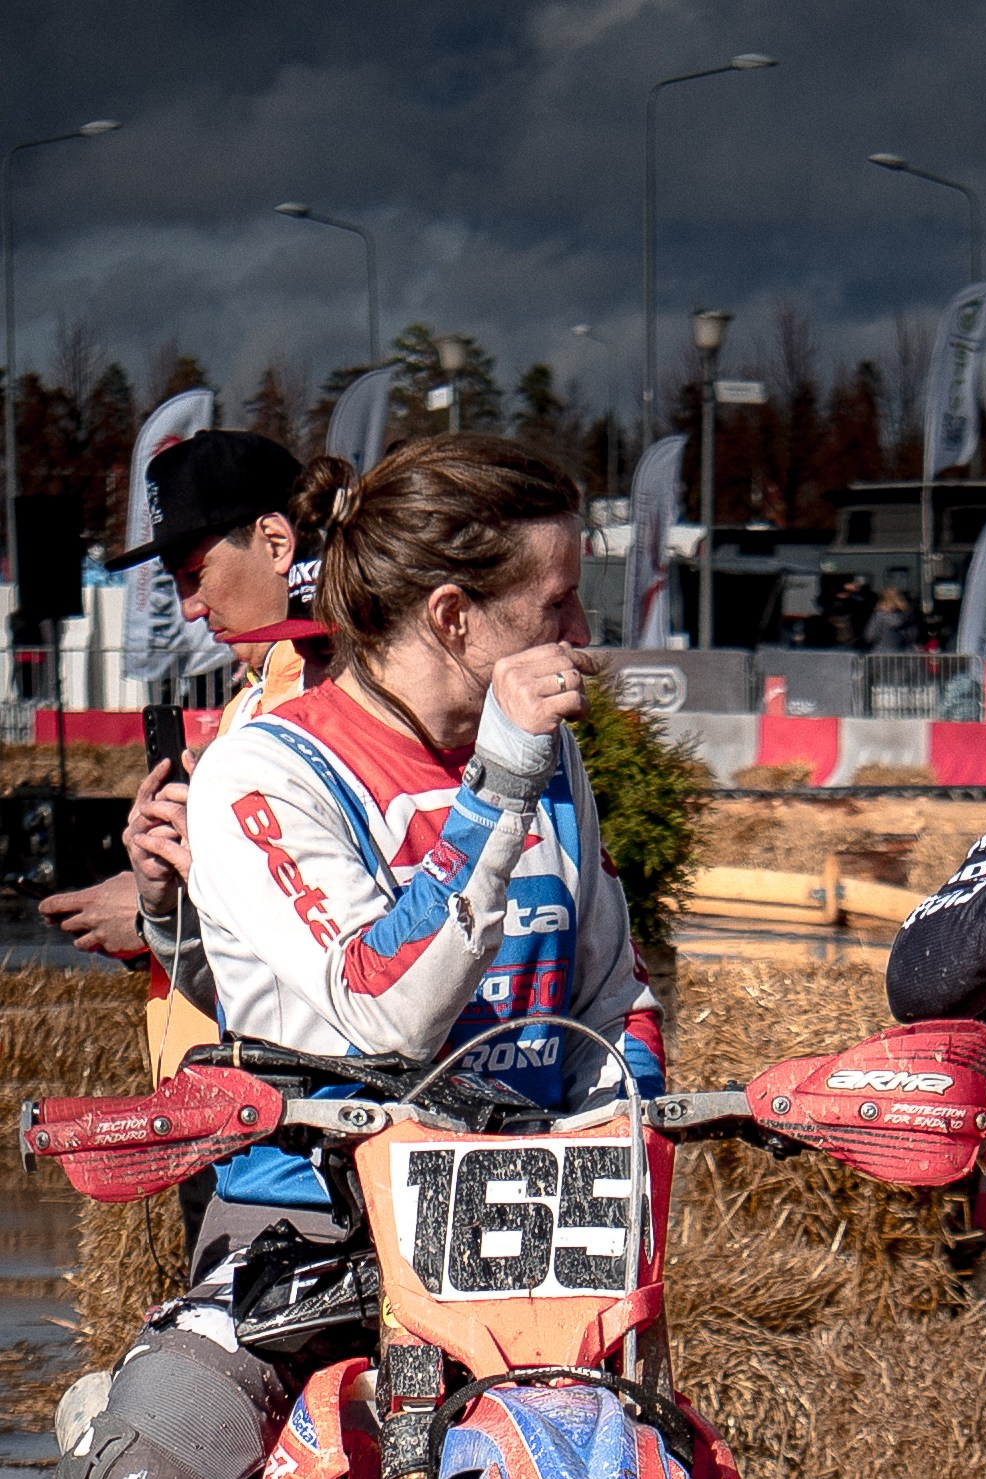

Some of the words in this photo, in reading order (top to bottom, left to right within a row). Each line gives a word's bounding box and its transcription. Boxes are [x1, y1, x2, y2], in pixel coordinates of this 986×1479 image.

[503, 898, 570, 937] ta
[95, 1116, 148, 1133] TECTION
[884, 1113, 910, 1124] FOR
[890, 1103, 967, 1119] PROTECTION
[407, 1147, 653, 1295] 165
[291, 1408, 317, 1445] Beta
